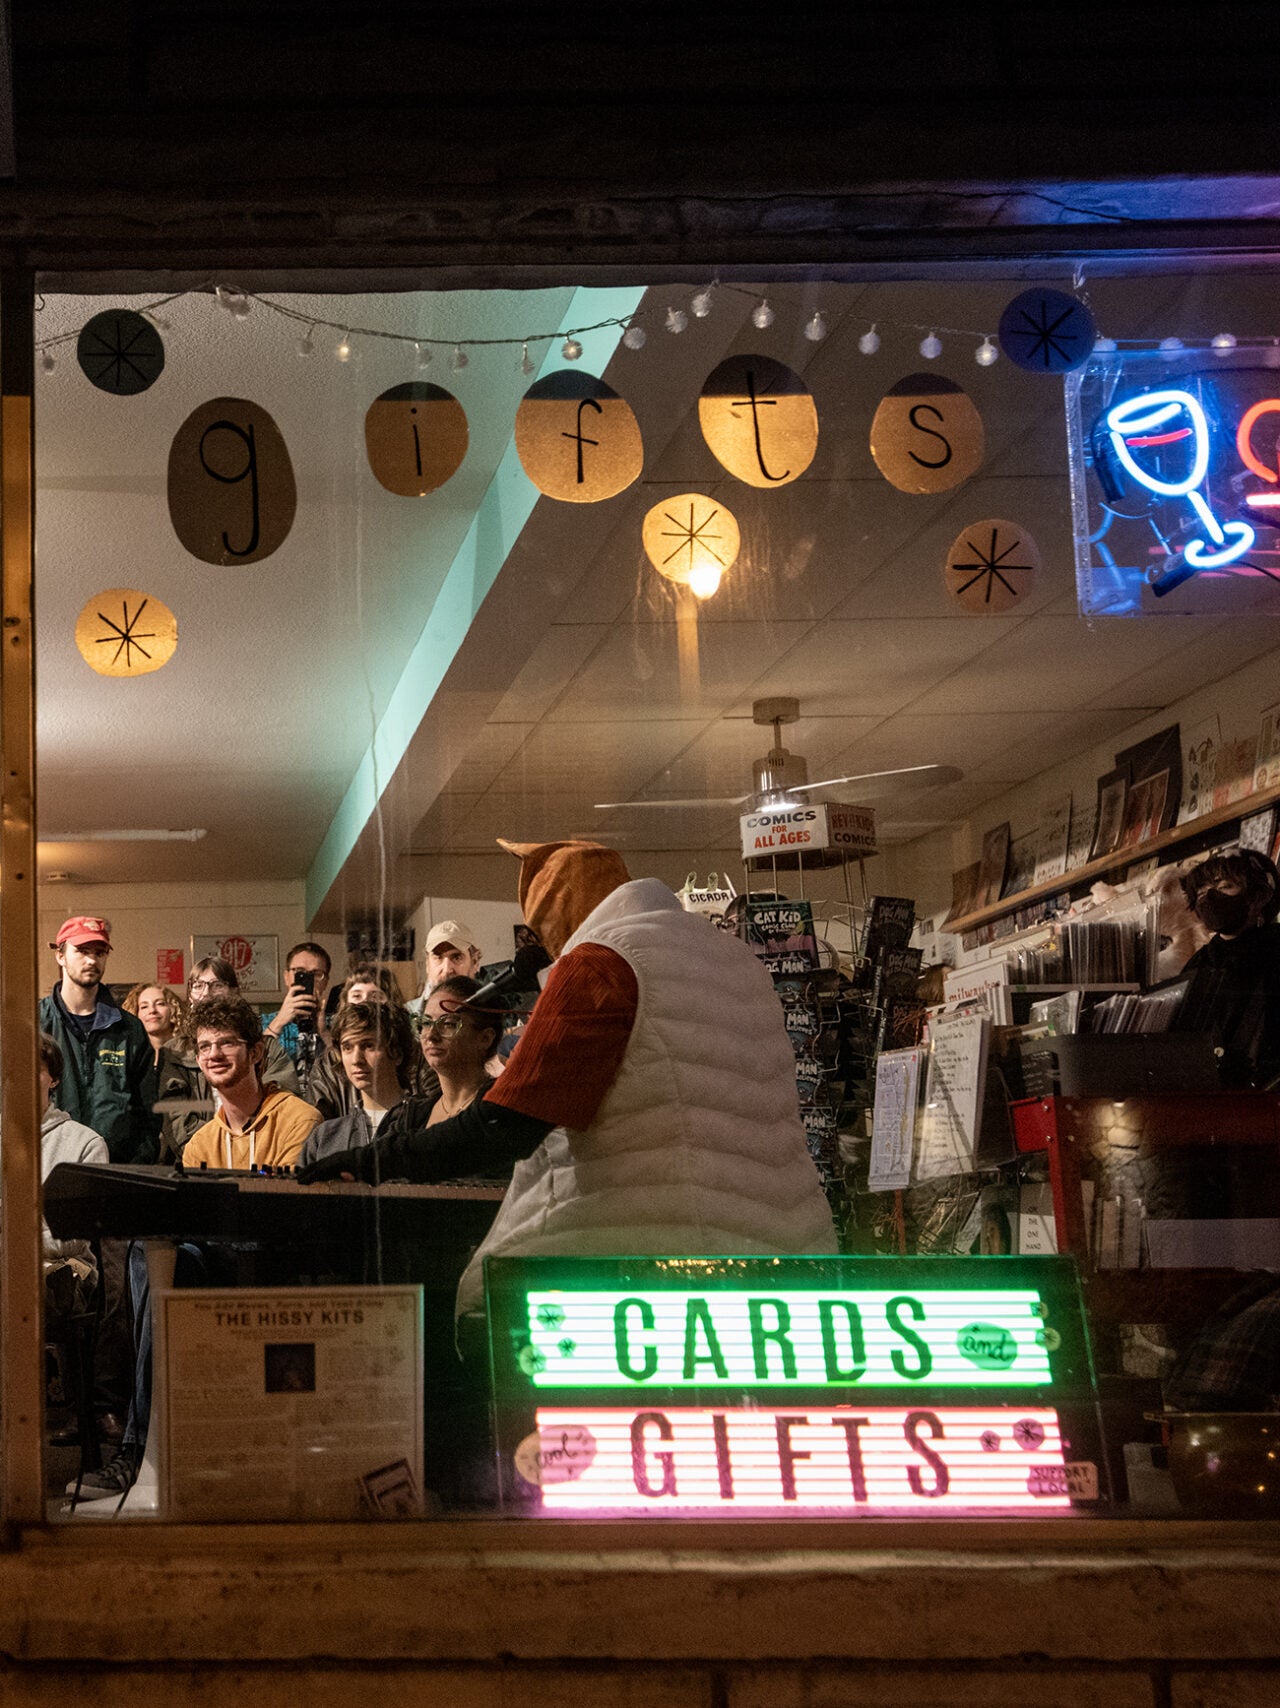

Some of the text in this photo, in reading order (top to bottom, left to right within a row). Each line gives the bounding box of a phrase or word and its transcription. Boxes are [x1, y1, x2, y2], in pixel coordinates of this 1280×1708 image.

[198, 371, 953, 557] gifts
[746, 810, 817, 828] COMICS
[771, 825, 787, 834] FOR
[754, 830, 811, 849] ALL AGES
[834, 832, 876, 846] COMICS
[689, 891, 729, 903] CICADA
[754, 910, 776, 924] CAT
[782, 961, 804, 973] MAN
[787, 1013, 809, 1026] MAN
[795, 1062, 818, 1075] MAN
[804, 1115, 826, 1128] MAN
[215, 1309, 364, 1326] THE HISSY KITS
[614, 1296, 933, 1382] CARDS
[963, 1333, 1012, 1362] and
[630, 1411, 950, 1502] GIFTS
[1033, 1466, 1089, 1481] SUPPORT
[1038, 1481, 1085, 1495] LOCAL
